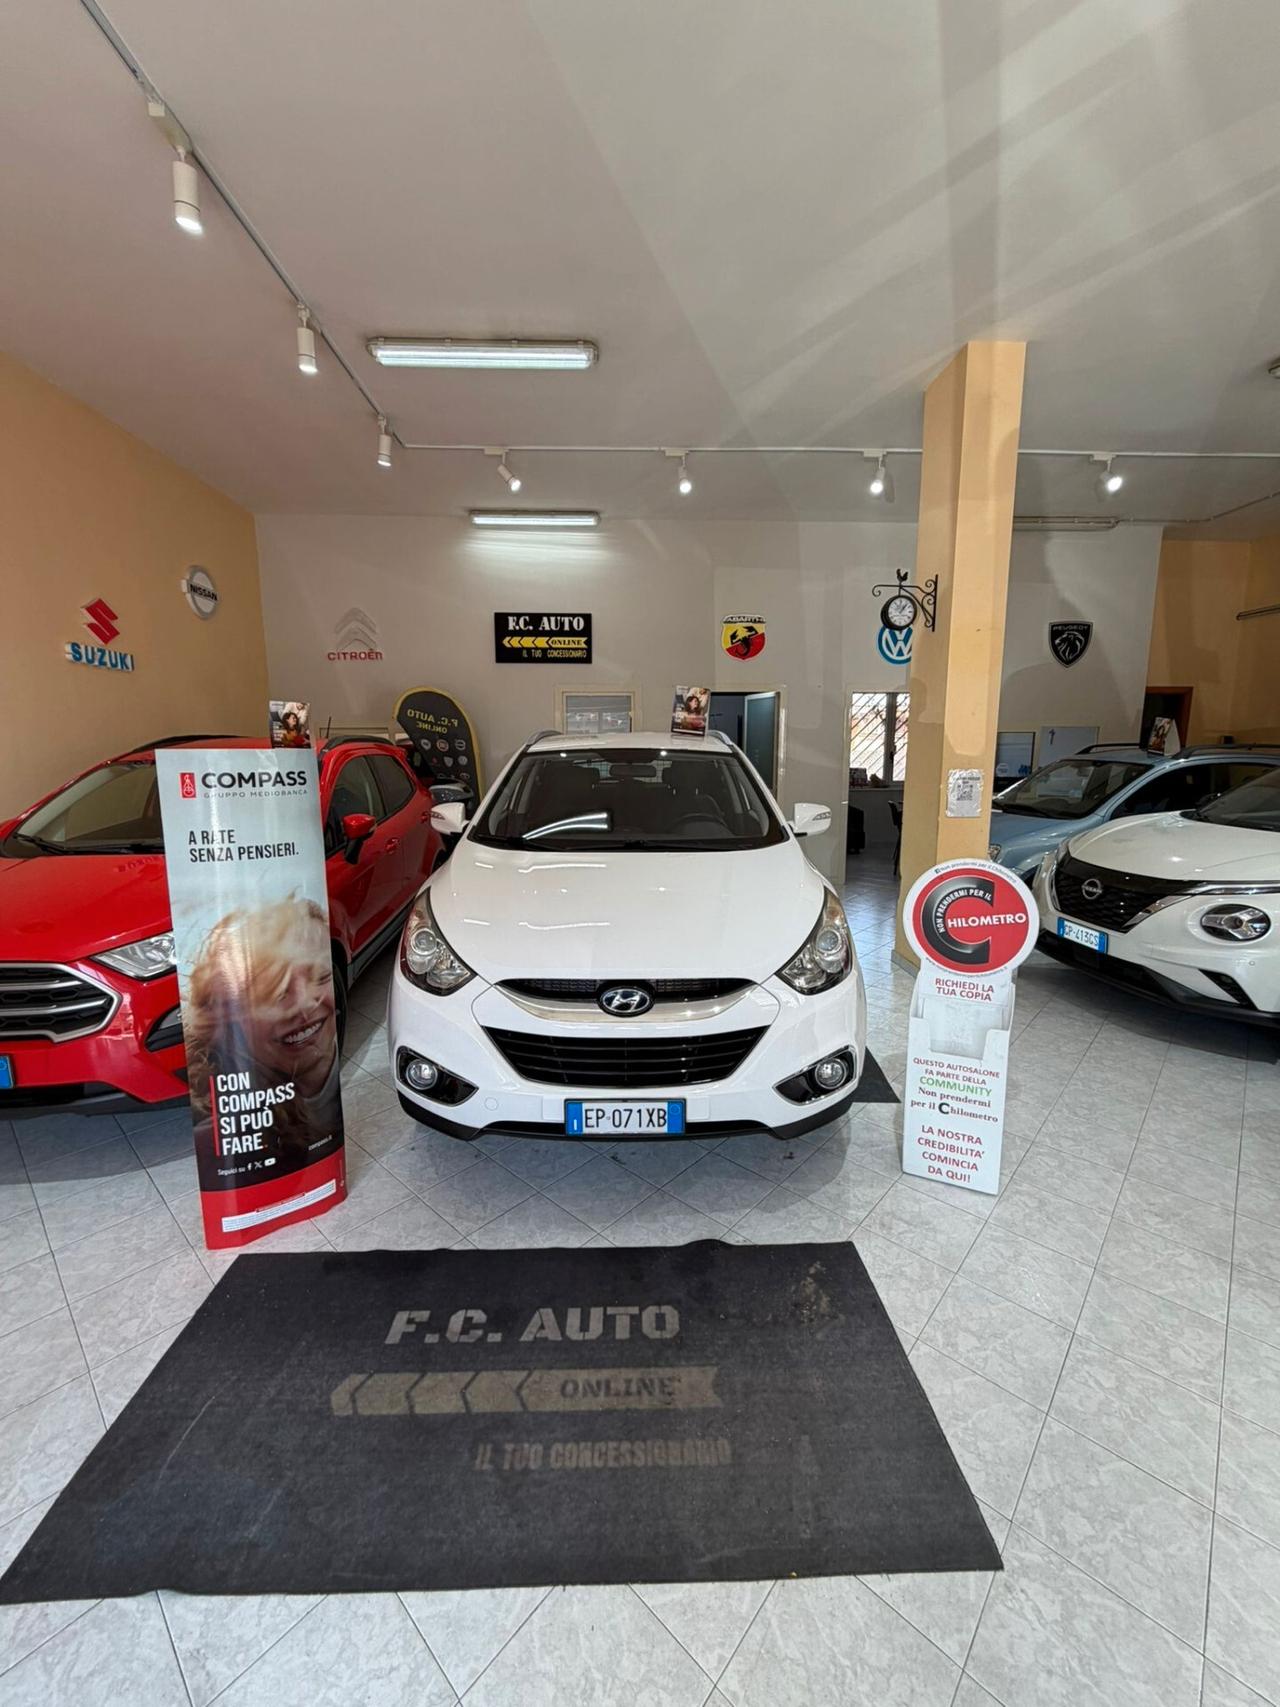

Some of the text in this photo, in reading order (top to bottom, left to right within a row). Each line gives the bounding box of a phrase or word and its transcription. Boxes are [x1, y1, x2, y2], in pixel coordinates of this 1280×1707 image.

[190, 584, 218, 601] NISSAN
[540, 616, 584, 631] AUTO
[532, 649, 542, 658] TUO
[547, 649, 587, 658] CONCESSIONARIO
[551, 639, 582, 647] ONLINE
[69, 642, 135, 671] SUZUKI
[201, 770, 308, 789] COMPASS
[250, 789, 308, 798] MEDIOBANCA
[188, 830, 198, 845] A
[190, 842, 300, 863] SENZA PENSIERI.
[936, 889, 992, 933] NON PRENDERMI PER IL
[935, 978, 994, 993] RICHIEDI LA
[936, 986, 992, 1001] TUA COPIA
[913, 1057, 1000, 1078] QUESTO AUTOSALONE
[925, 1068, 987, 1085] FA PARTE DELLA
[216, 1071, 250, 1092] CON
[919, 1076, 992, 1097] COMMUNITY
[218, 1082, 296, 1113] COMPASS
[918, 1086, 991, 1108] Non prendermi
[220, 1106, 274, 1135] SI PUÒ
[910, 1099, 999, 1122] per il Chilometro
[222, 1132, 268, 1156] FARE.
[921, 1125, 983, 1146] LA NOSTRA
[922, 1151, 979, 1171] COMINCIA
[217, 1168, 237, 1176] Seguici
[927, 1165, 971, 1183] DA QUI!
[384, 1305, 681, 1344] F.C. AUTO
[559, 1376, 677, 1399] ONLINE
[503, 1442, 545, 1471] TUO
[549, 1438, 733, 1469] CONCESSIONARIO
